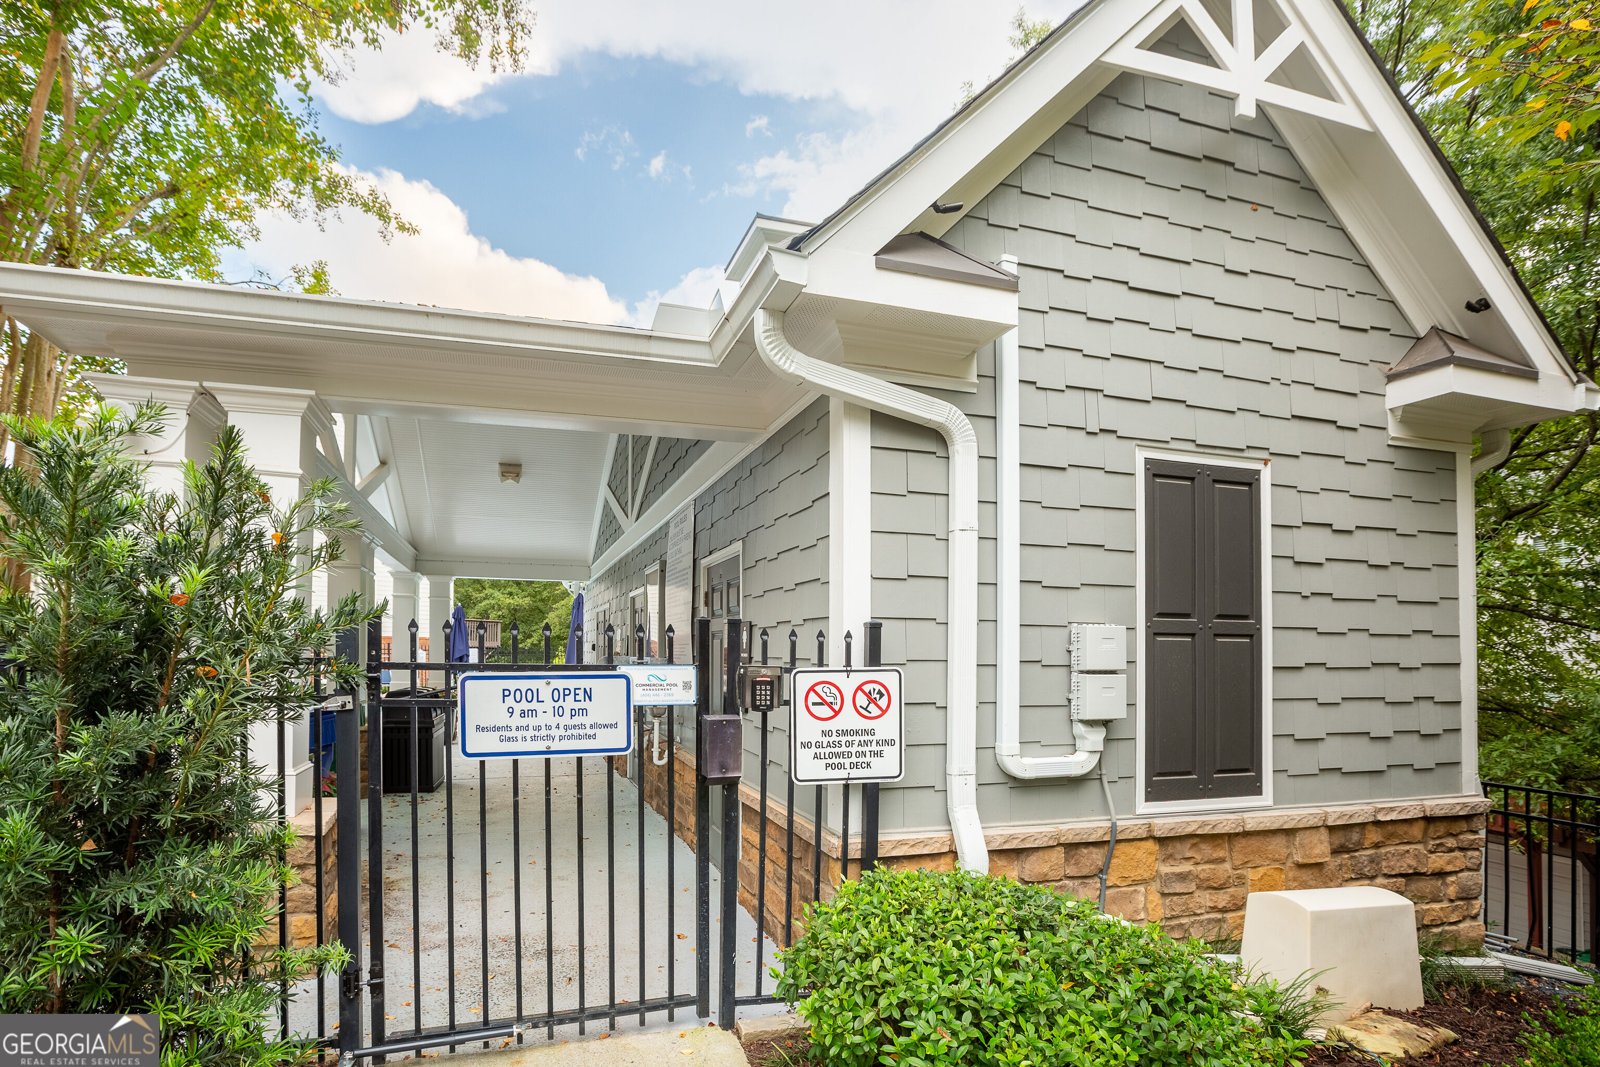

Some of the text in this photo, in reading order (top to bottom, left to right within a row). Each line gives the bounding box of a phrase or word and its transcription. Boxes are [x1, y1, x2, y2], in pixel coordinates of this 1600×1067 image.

[502, 687, 592, 703] POOL OPEN
[507, 706, 514, 718] 9
[519, 709, 538, 718] am
[552, 706, 564, 718] 10
[570, 707, 588, 719] pm
[476, 724, 512, 732] Residents
[515, 723, 529, 732] and
[532, 725, 542, 733] up
[563, 722, 586, 732] guests
[589, 721, 618, 730] allowed
[821, 728, 876, 737] NO SMOKING
[498, 734, 518, 743] Glass
[530, 734, 556, 742] strictly
[558, 733, 597, 742] prohibited
[800, 741, 812, 749] NO
[815, 740, 842, 748] GLASS
[857, 739, 873, 747] ANY
[876, 738, 896, 747] KIND
[813, 751, 852, 760] ALLOWED
[825, 761, 872, 770] POOL DECK
